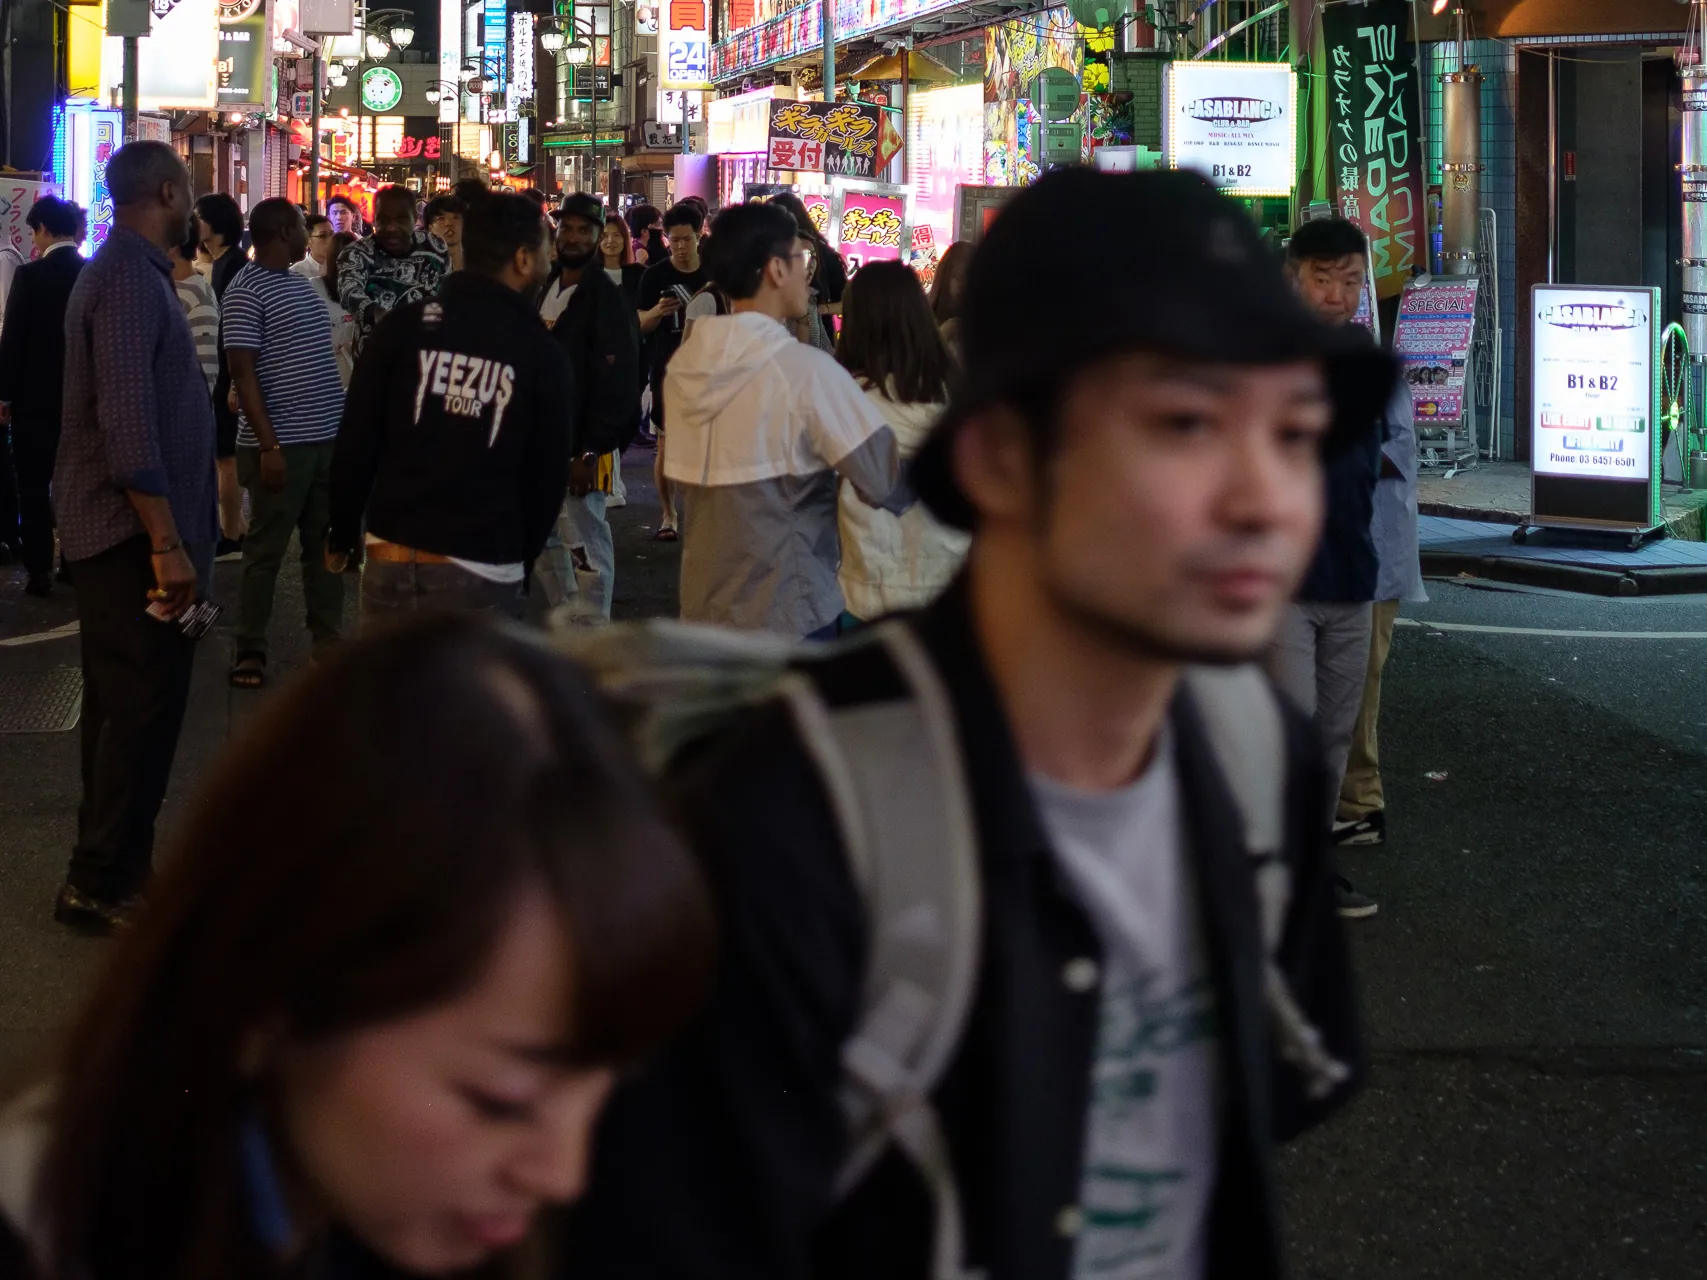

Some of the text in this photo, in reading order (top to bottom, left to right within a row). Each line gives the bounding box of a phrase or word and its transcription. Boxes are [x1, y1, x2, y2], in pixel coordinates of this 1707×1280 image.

[671, 42, 705, 69] 24
[669, 70, 705, 80] OPEN
[1183, 98, 1281, 119] CASABLANCA
[772, 103, 878, 137] ギラギラ
[1213, 120, 1230, 129] CLUB
[813, 128, 878, 158] ガールズ
[771, 140, 824, 168] 受付
[1213, 164, 1251, 177] B1 & B2
[843, 208, 902, 232] ギラギラ
[842, 228, 901, 248] ガールズ
[1407, 299, 1469, 312] SPECIAL
[416, 349, 516, 427] YEEZUS
[1567, 374, 1618, 391] B1 & B2
[444, 394, 482, 417] TOUR
[1579, 455, 1636, 467] 03-6457-6501
